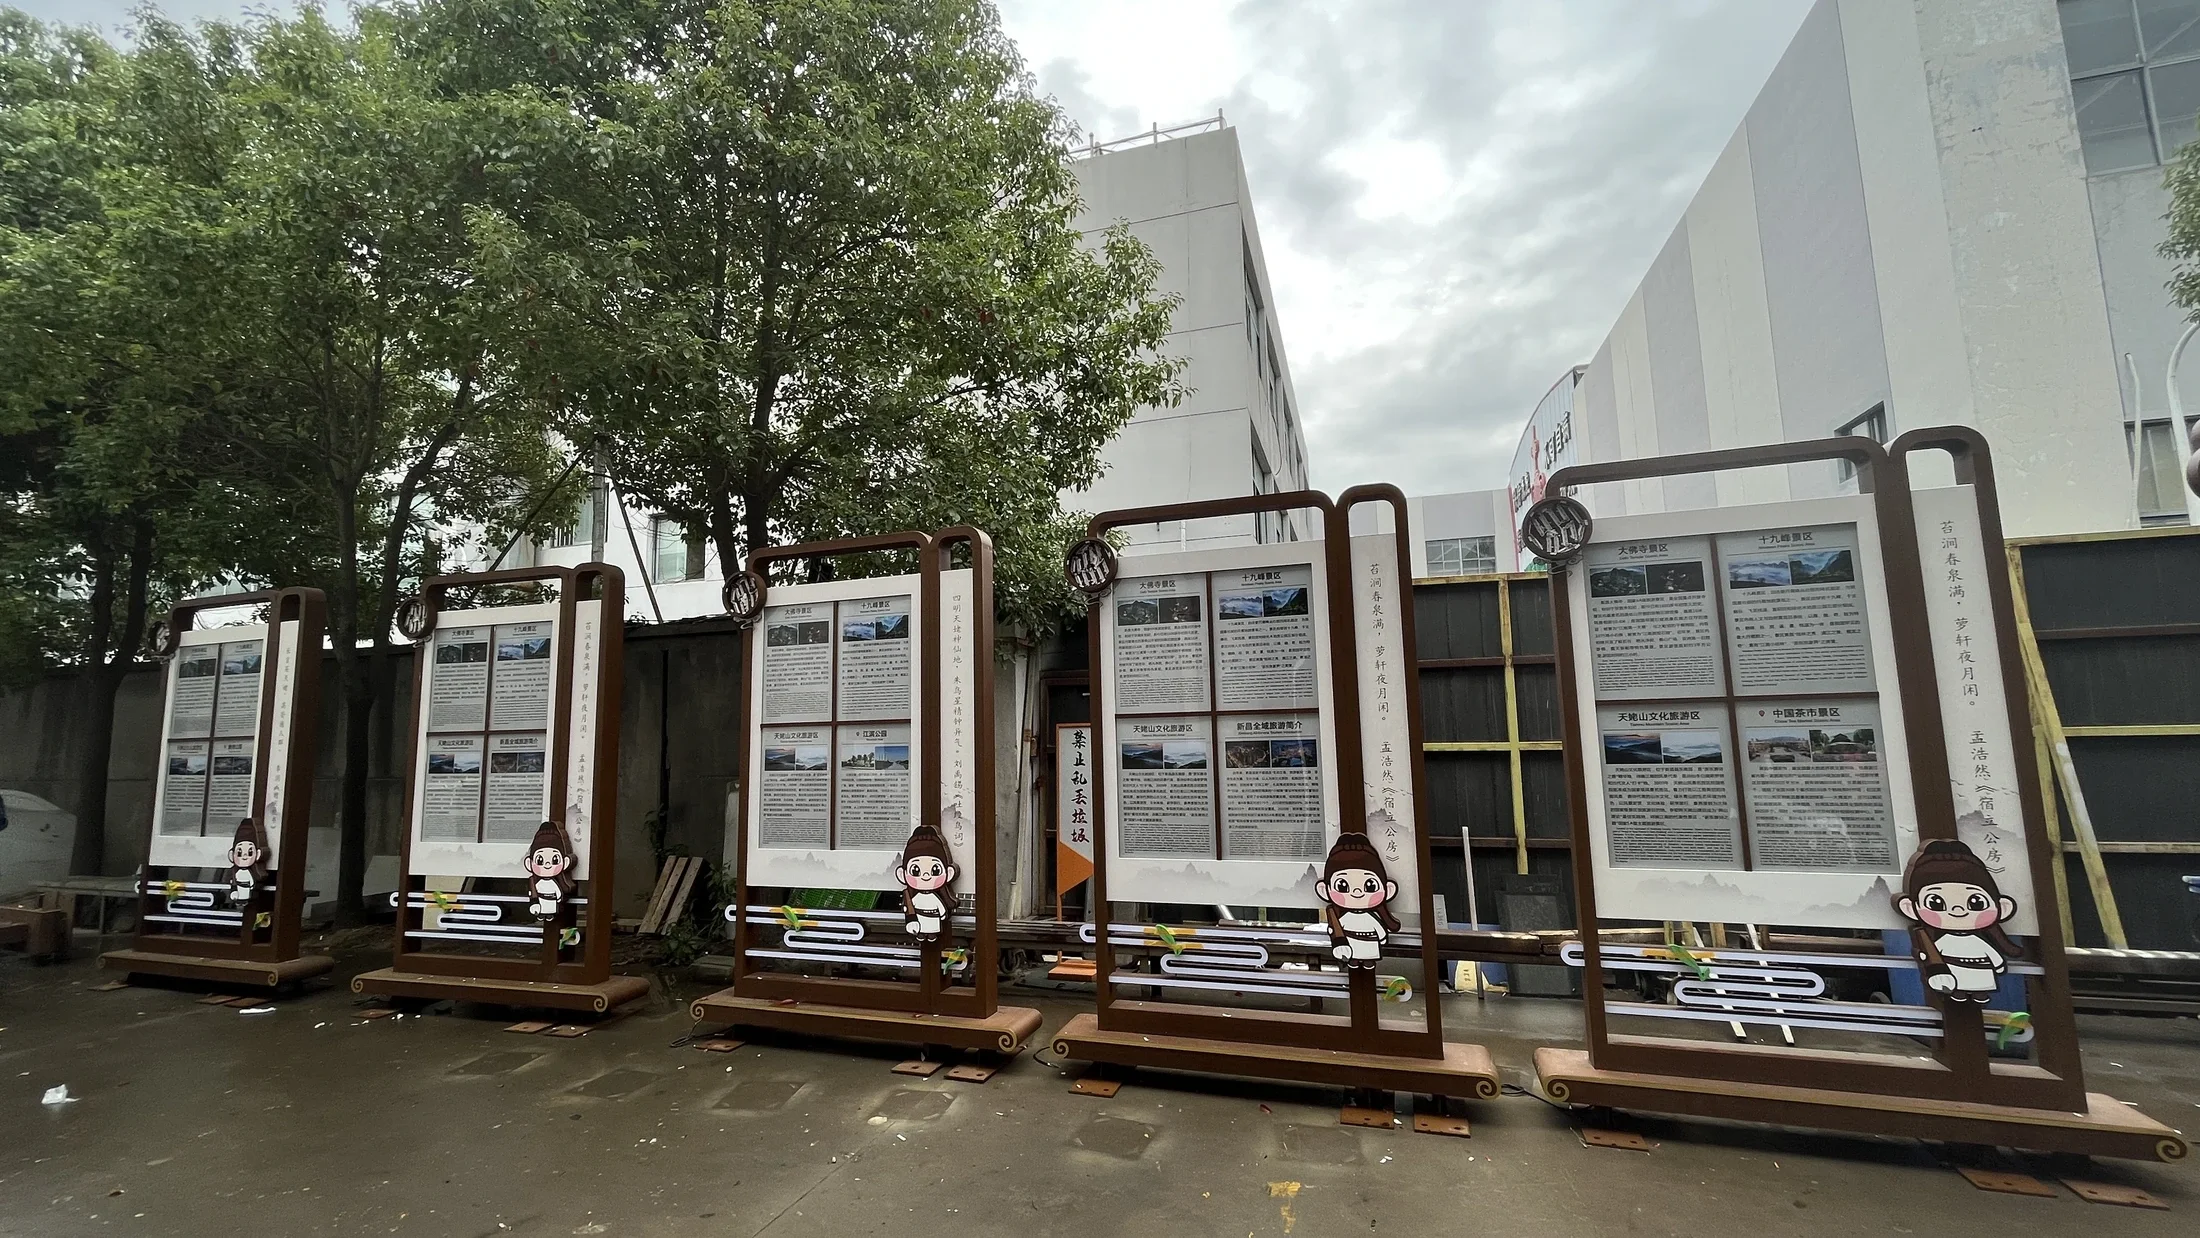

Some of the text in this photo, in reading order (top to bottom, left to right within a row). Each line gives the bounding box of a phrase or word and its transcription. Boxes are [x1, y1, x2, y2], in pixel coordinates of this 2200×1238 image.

[1758, 532, 1813, 544] 十九峰景区
[1618, 543, 1668, 555] 大佛寺景区
[1242, 571, 1281, 582] 十九峰景区
[1618, 711, 1701, 722] 天姥山文化旅游区
[1772, 707, 1840, 718] 中国茶市景区
[1133, 724, 1192, 733] 天姥山文化旅游区
[1237, 721, 1302, 730] 新昌全域旅游简介
[1071, 730, 1090, 843] 禁止乱丢垃圾
